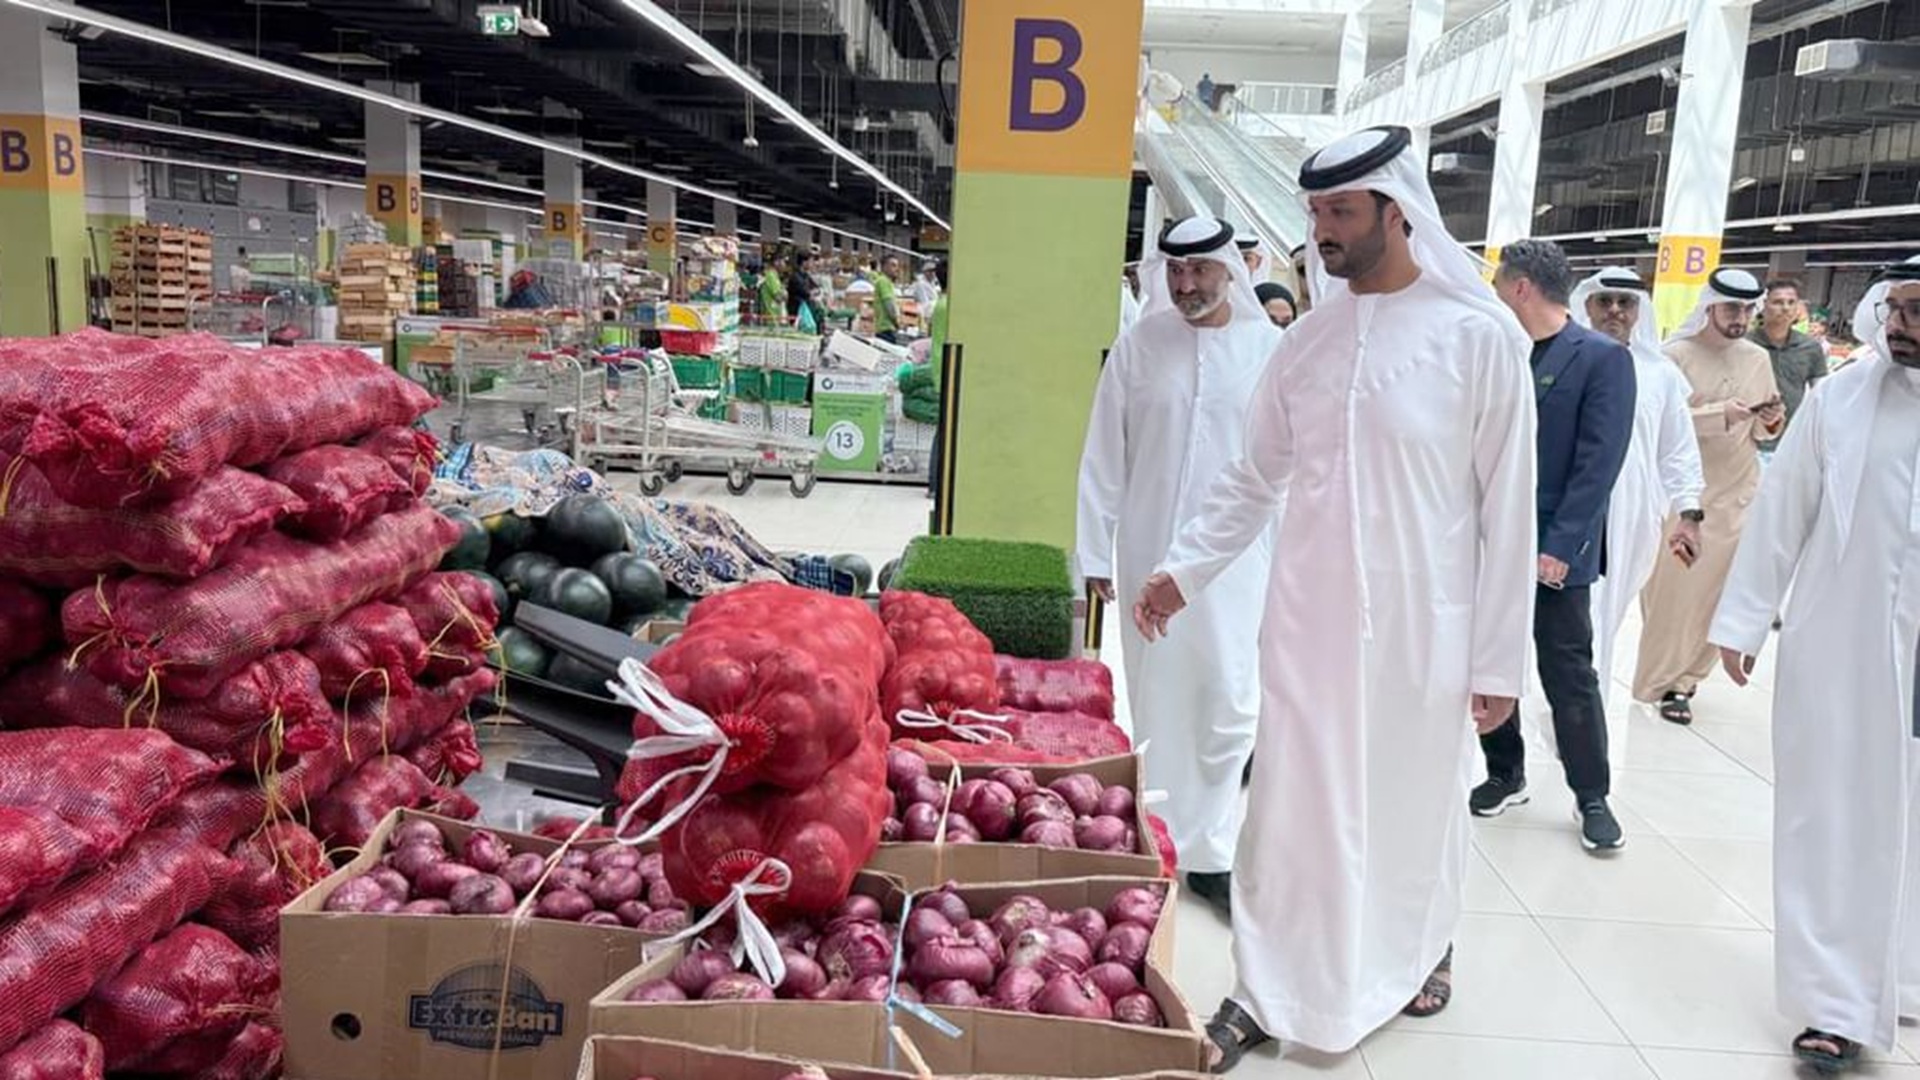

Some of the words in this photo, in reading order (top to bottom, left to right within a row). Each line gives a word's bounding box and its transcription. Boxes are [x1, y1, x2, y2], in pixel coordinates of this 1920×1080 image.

[1009, 18, 1086, 131] B
[1, 130, 30, 172] B
[54, 133, 75, 175] B
[377, 184, 396, 212] B
[553, 211, 566, 231] B
[652, 227, 666, 243] C
[1660, 246, 1670, 272] B
[1685, 246, 1705, 273] B
[836, 432, 853, 449] 13
[413, 1000, 557, 1031] ExtraBan
